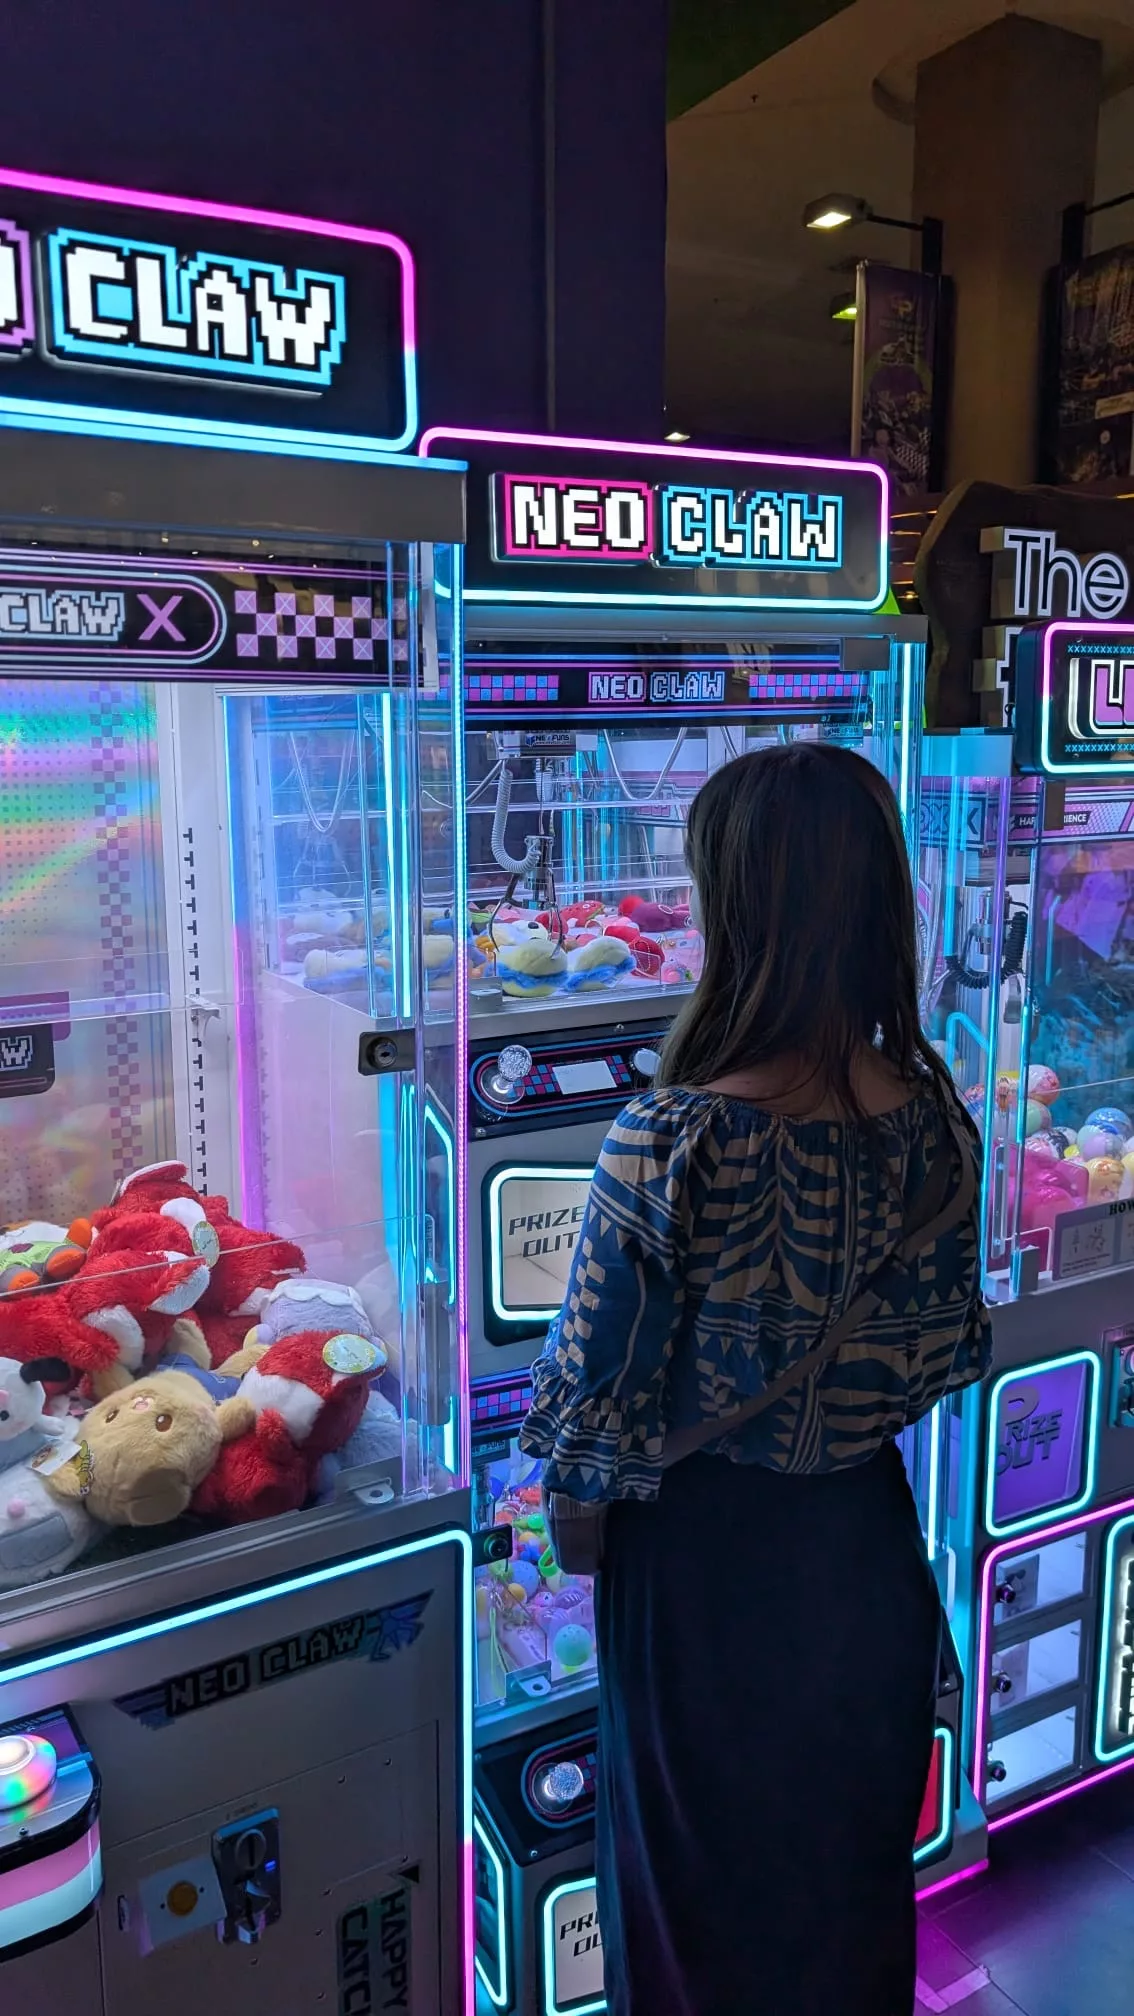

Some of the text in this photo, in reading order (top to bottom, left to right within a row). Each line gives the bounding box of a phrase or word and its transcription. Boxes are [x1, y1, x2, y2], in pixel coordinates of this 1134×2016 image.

[64, 244, 333, 366] CLAW
[512, 484, 837, 561] NEO CLAW
[1004, 527, 1130, 620] The
[0, 593, 120, 635] CLAW
[590, 674, 723, 700] NEO CLAW
[508, 1205, 585, 1236] PRIZE
[522, 1230, 580, 1258] OUT
[169, 1617, 364, 1716] NEO CLAW
[380, 1887, 409, 2010] HAPPY
